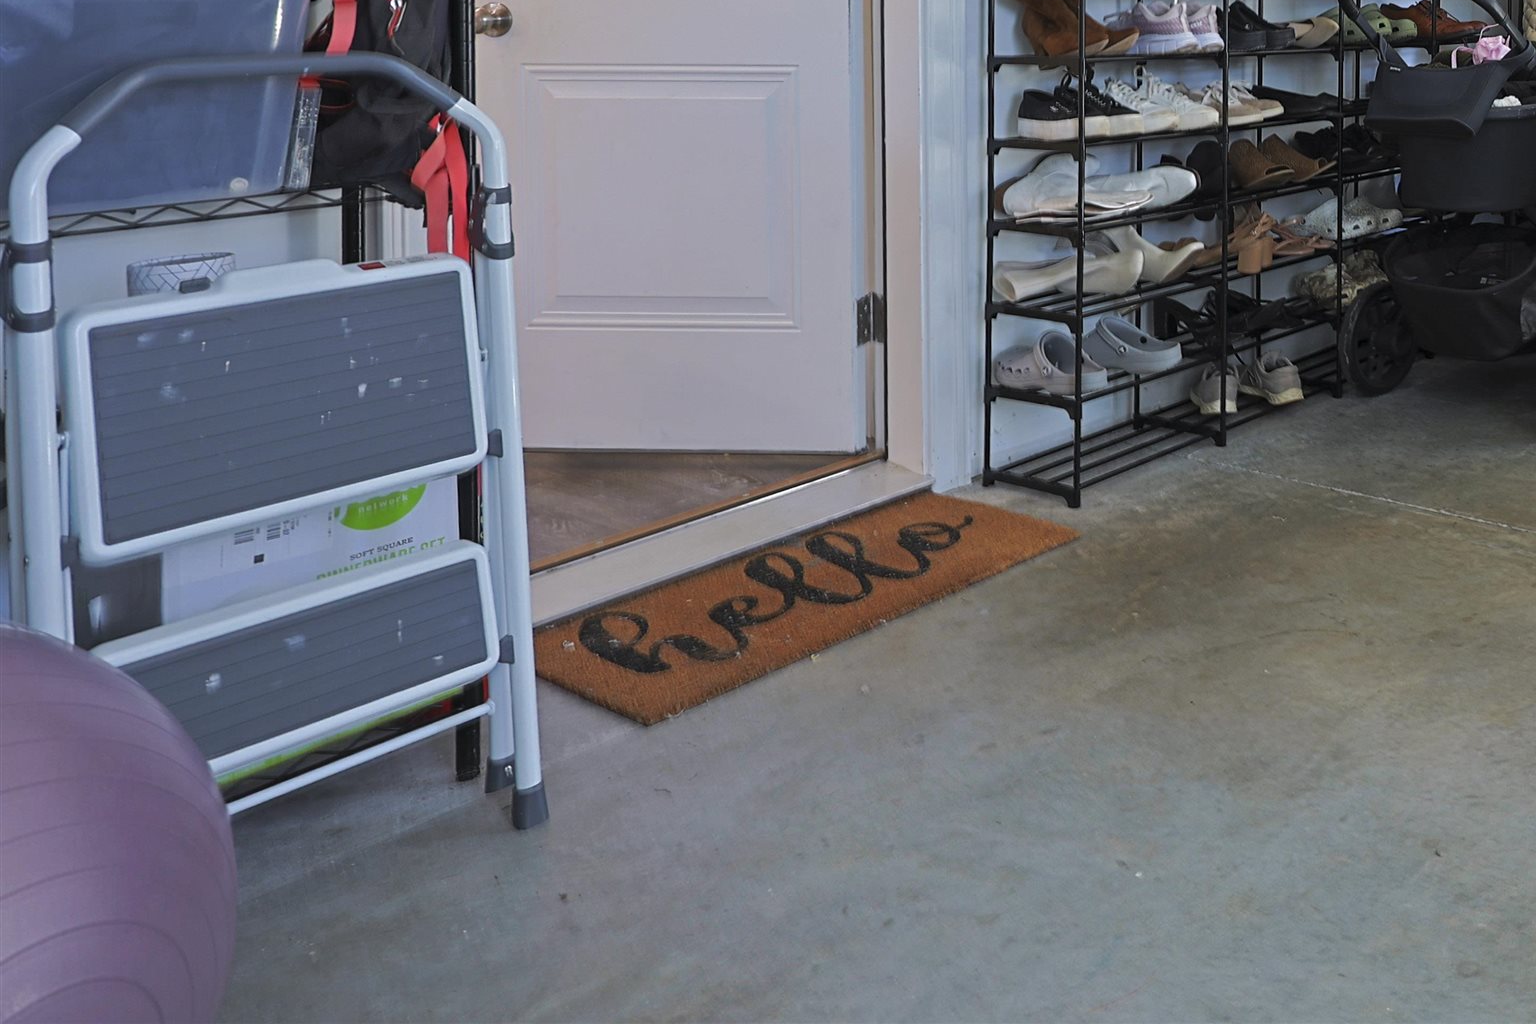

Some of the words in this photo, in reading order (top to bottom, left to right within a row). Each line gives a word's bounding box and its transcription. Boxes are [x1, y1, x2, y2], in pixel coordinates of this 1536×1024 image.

[358, 493, 409, 513] network
[349, 547, 375, 561] SOFT
[376, 536, 414, 553] SQUARE
[579, 515, 973, 674] hello
